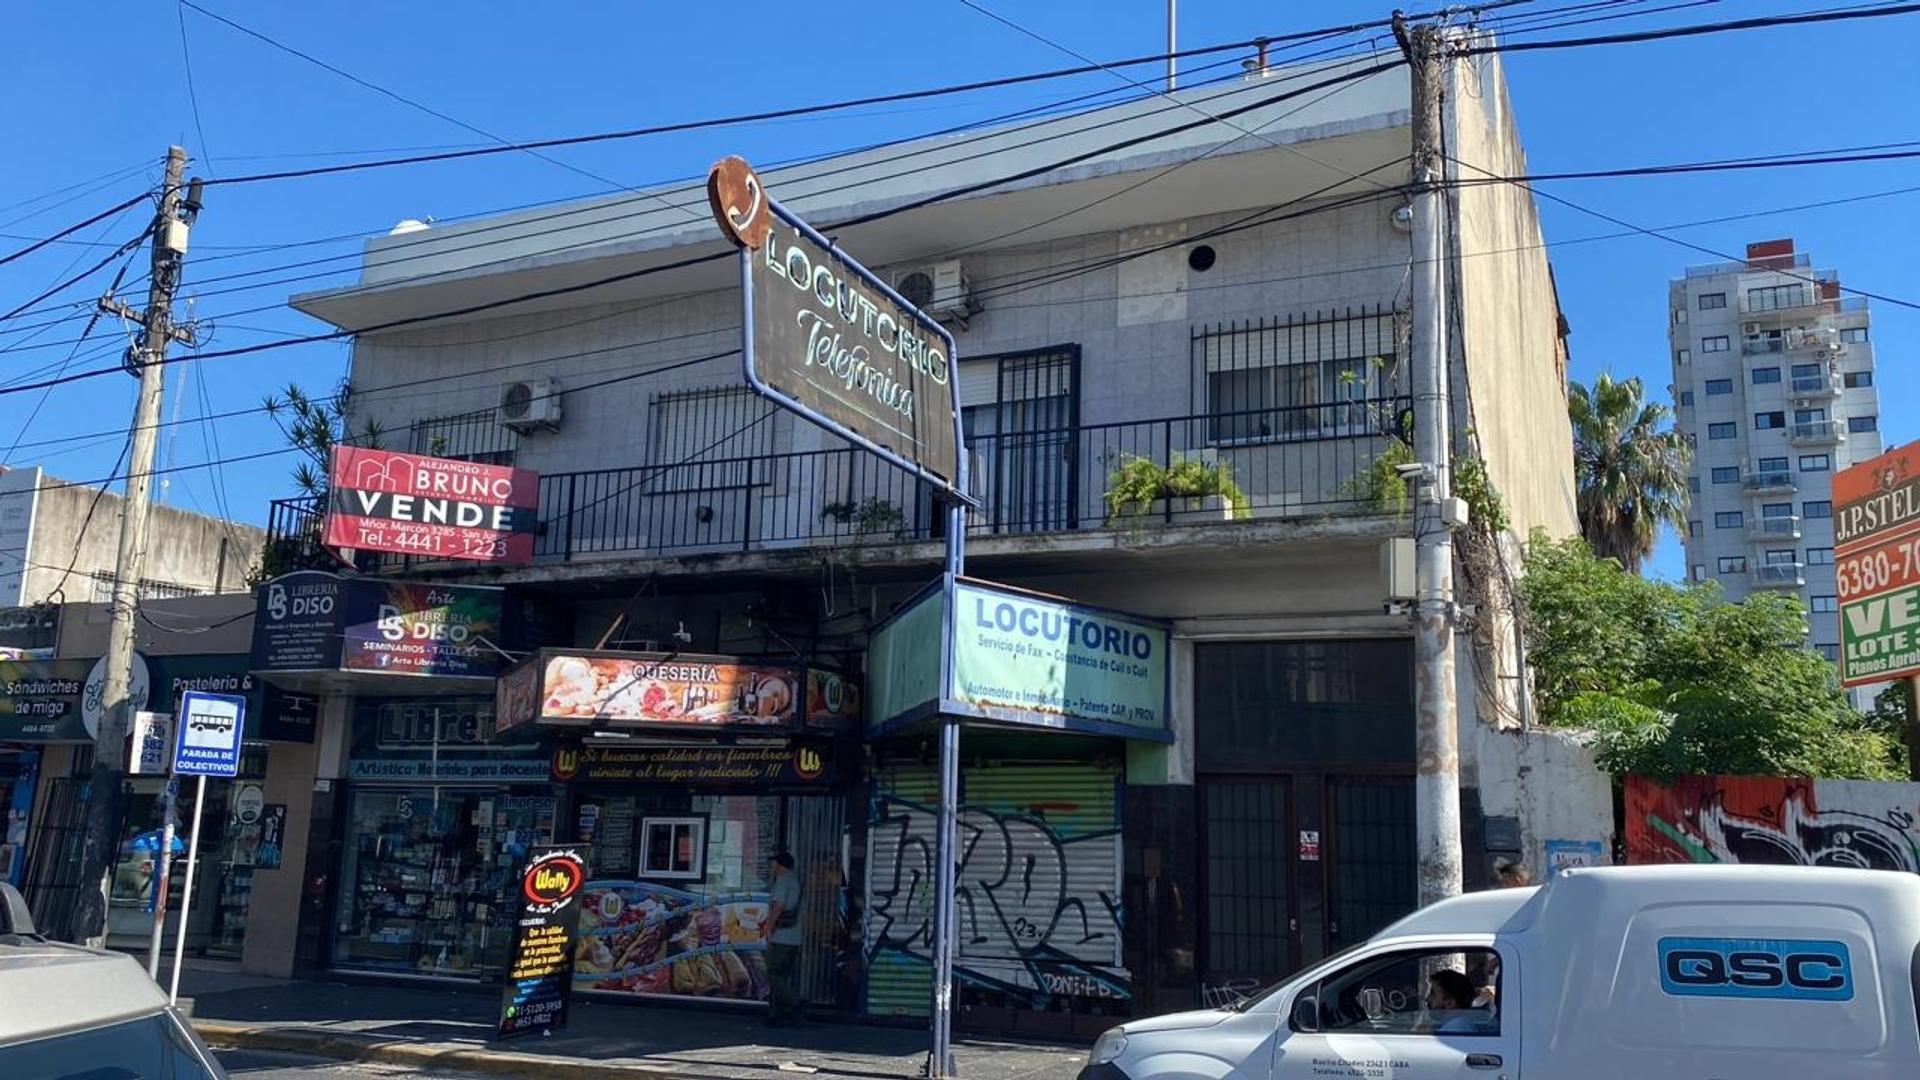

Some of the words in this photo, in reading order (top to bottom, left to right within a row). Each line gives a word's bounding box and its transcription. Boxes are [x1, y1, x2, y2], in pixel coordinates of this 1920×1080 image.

[766, 228, 948, 386] LOCUTORIO
[418, 459, 480, 475] ALEJANDRO
[416, 470, 513, 499] BRUNO
[357, 489, 514, 531] VENDE
[391, 522, 429, 534] Marcón
[463, 529, 480, 539] San
[395, 532, 441, 551] 4441
[463, 538, 507, 557] 1223
[292, 596, 334, 615] DISO
[1845, 589, 1920, 637] VE
[413, 623, 468, 642] DISO
[976, 598, 1151, 660] LOCUTORIO
[363, 642, 425, 654] SEMINARIOS
[977, 633, 1014, 653] Servicio
[1027, 645, 1043, 657] Fax
[1054, 648, 1098, 670] Constancia
[1100, 660, 1110, 671] de
[1848, 631, 1909, 660] LOTE
[392, 656, 411, 665] Arte
[1849, 658, 1887, 676] Planos
[632, 663, 719, 683] QUESERÍA
[6, 680, 80, 695] Sandwiches
[967, 682, 1014, 700] Automotor
[15, 700, 30, 714] de
[32, 699, 65, 719] miga
[181, 748, 218, 759] PARADA
[221, 751, 234, 760] DE
[650, 748, 703, 763] calidad
[706, 751, 723, 761] en
[726, 748, 793, 765] fiambres
[177, 761, 235, 772] COLECTIVOS
[470, 764, 497, 778] para
[636, 763, 653, 778] al
[656, 764, 696, 782] lugar
[699, 764, 760, 778] indicado
[535, 869, 571, 892] Wally
[1666, 950, 1845, 989] QSC
